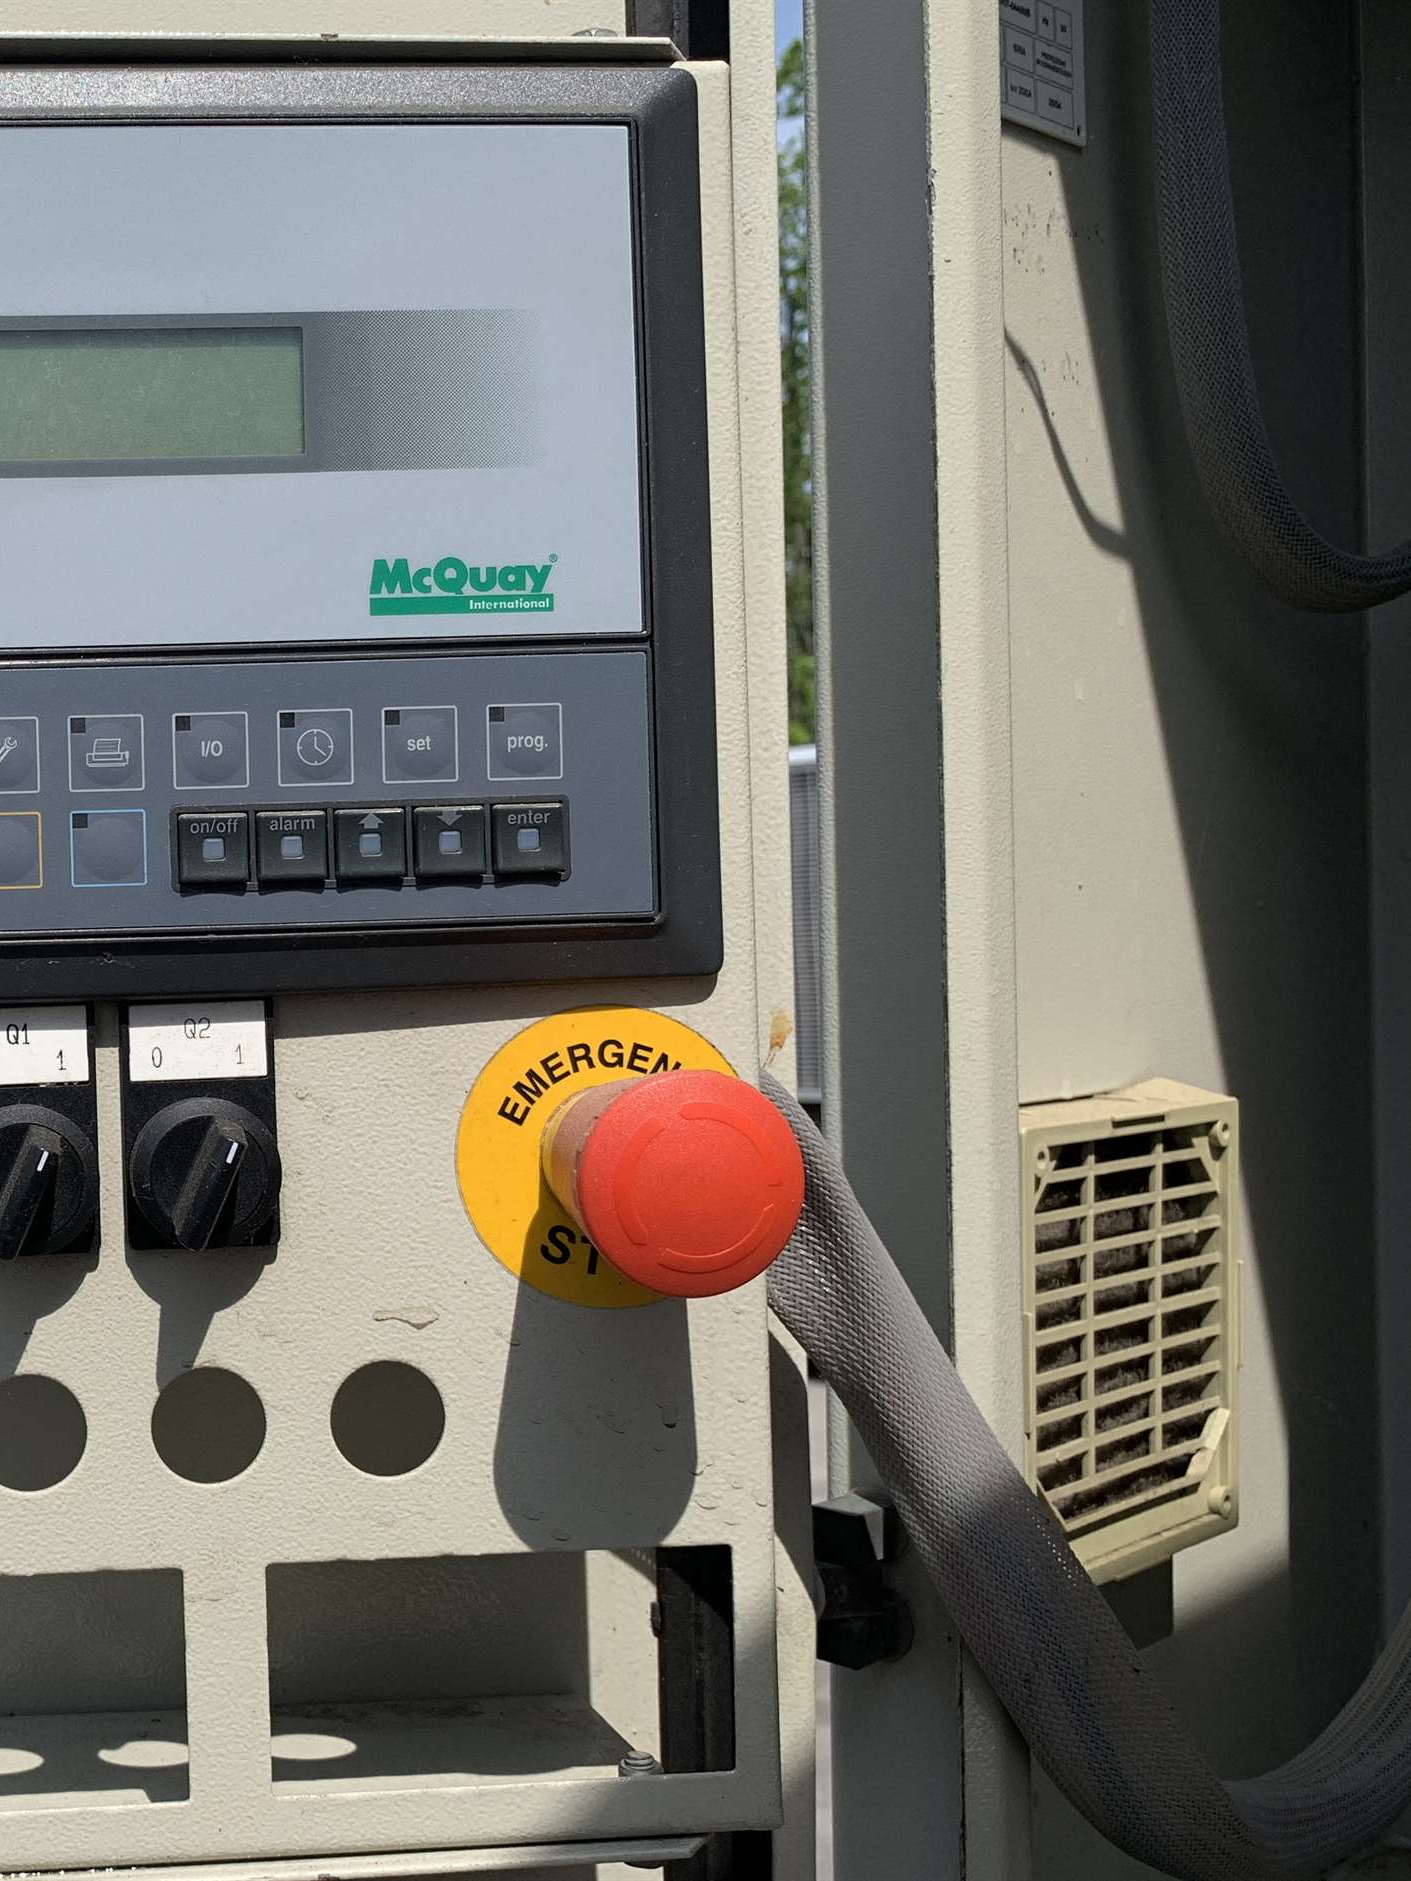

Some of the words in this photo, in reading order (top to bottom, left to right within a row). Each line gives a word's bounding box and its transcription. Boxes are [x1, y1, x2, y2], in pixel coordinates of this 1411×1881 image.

[469, 597, 550, 610] International
[201, 740, 223, 758] I/O
[407, 736, 432, 752] set
[507, 733, 549, 753] prog.
[190, 816, 239, 835] on/off
[269, 815, 316, 832] alarm
[507, 809, 551, 827] enter
[6, 1023, 30, 1046] Q1
[184, 1017, 212, 1040] Q2
[56, 1049, 67, 1071] 1
[235, 1044, 245, 1065] 1
[498, 1039, 682, 1126] EMERGEN
[540, 1225, 603, 1275] ST
